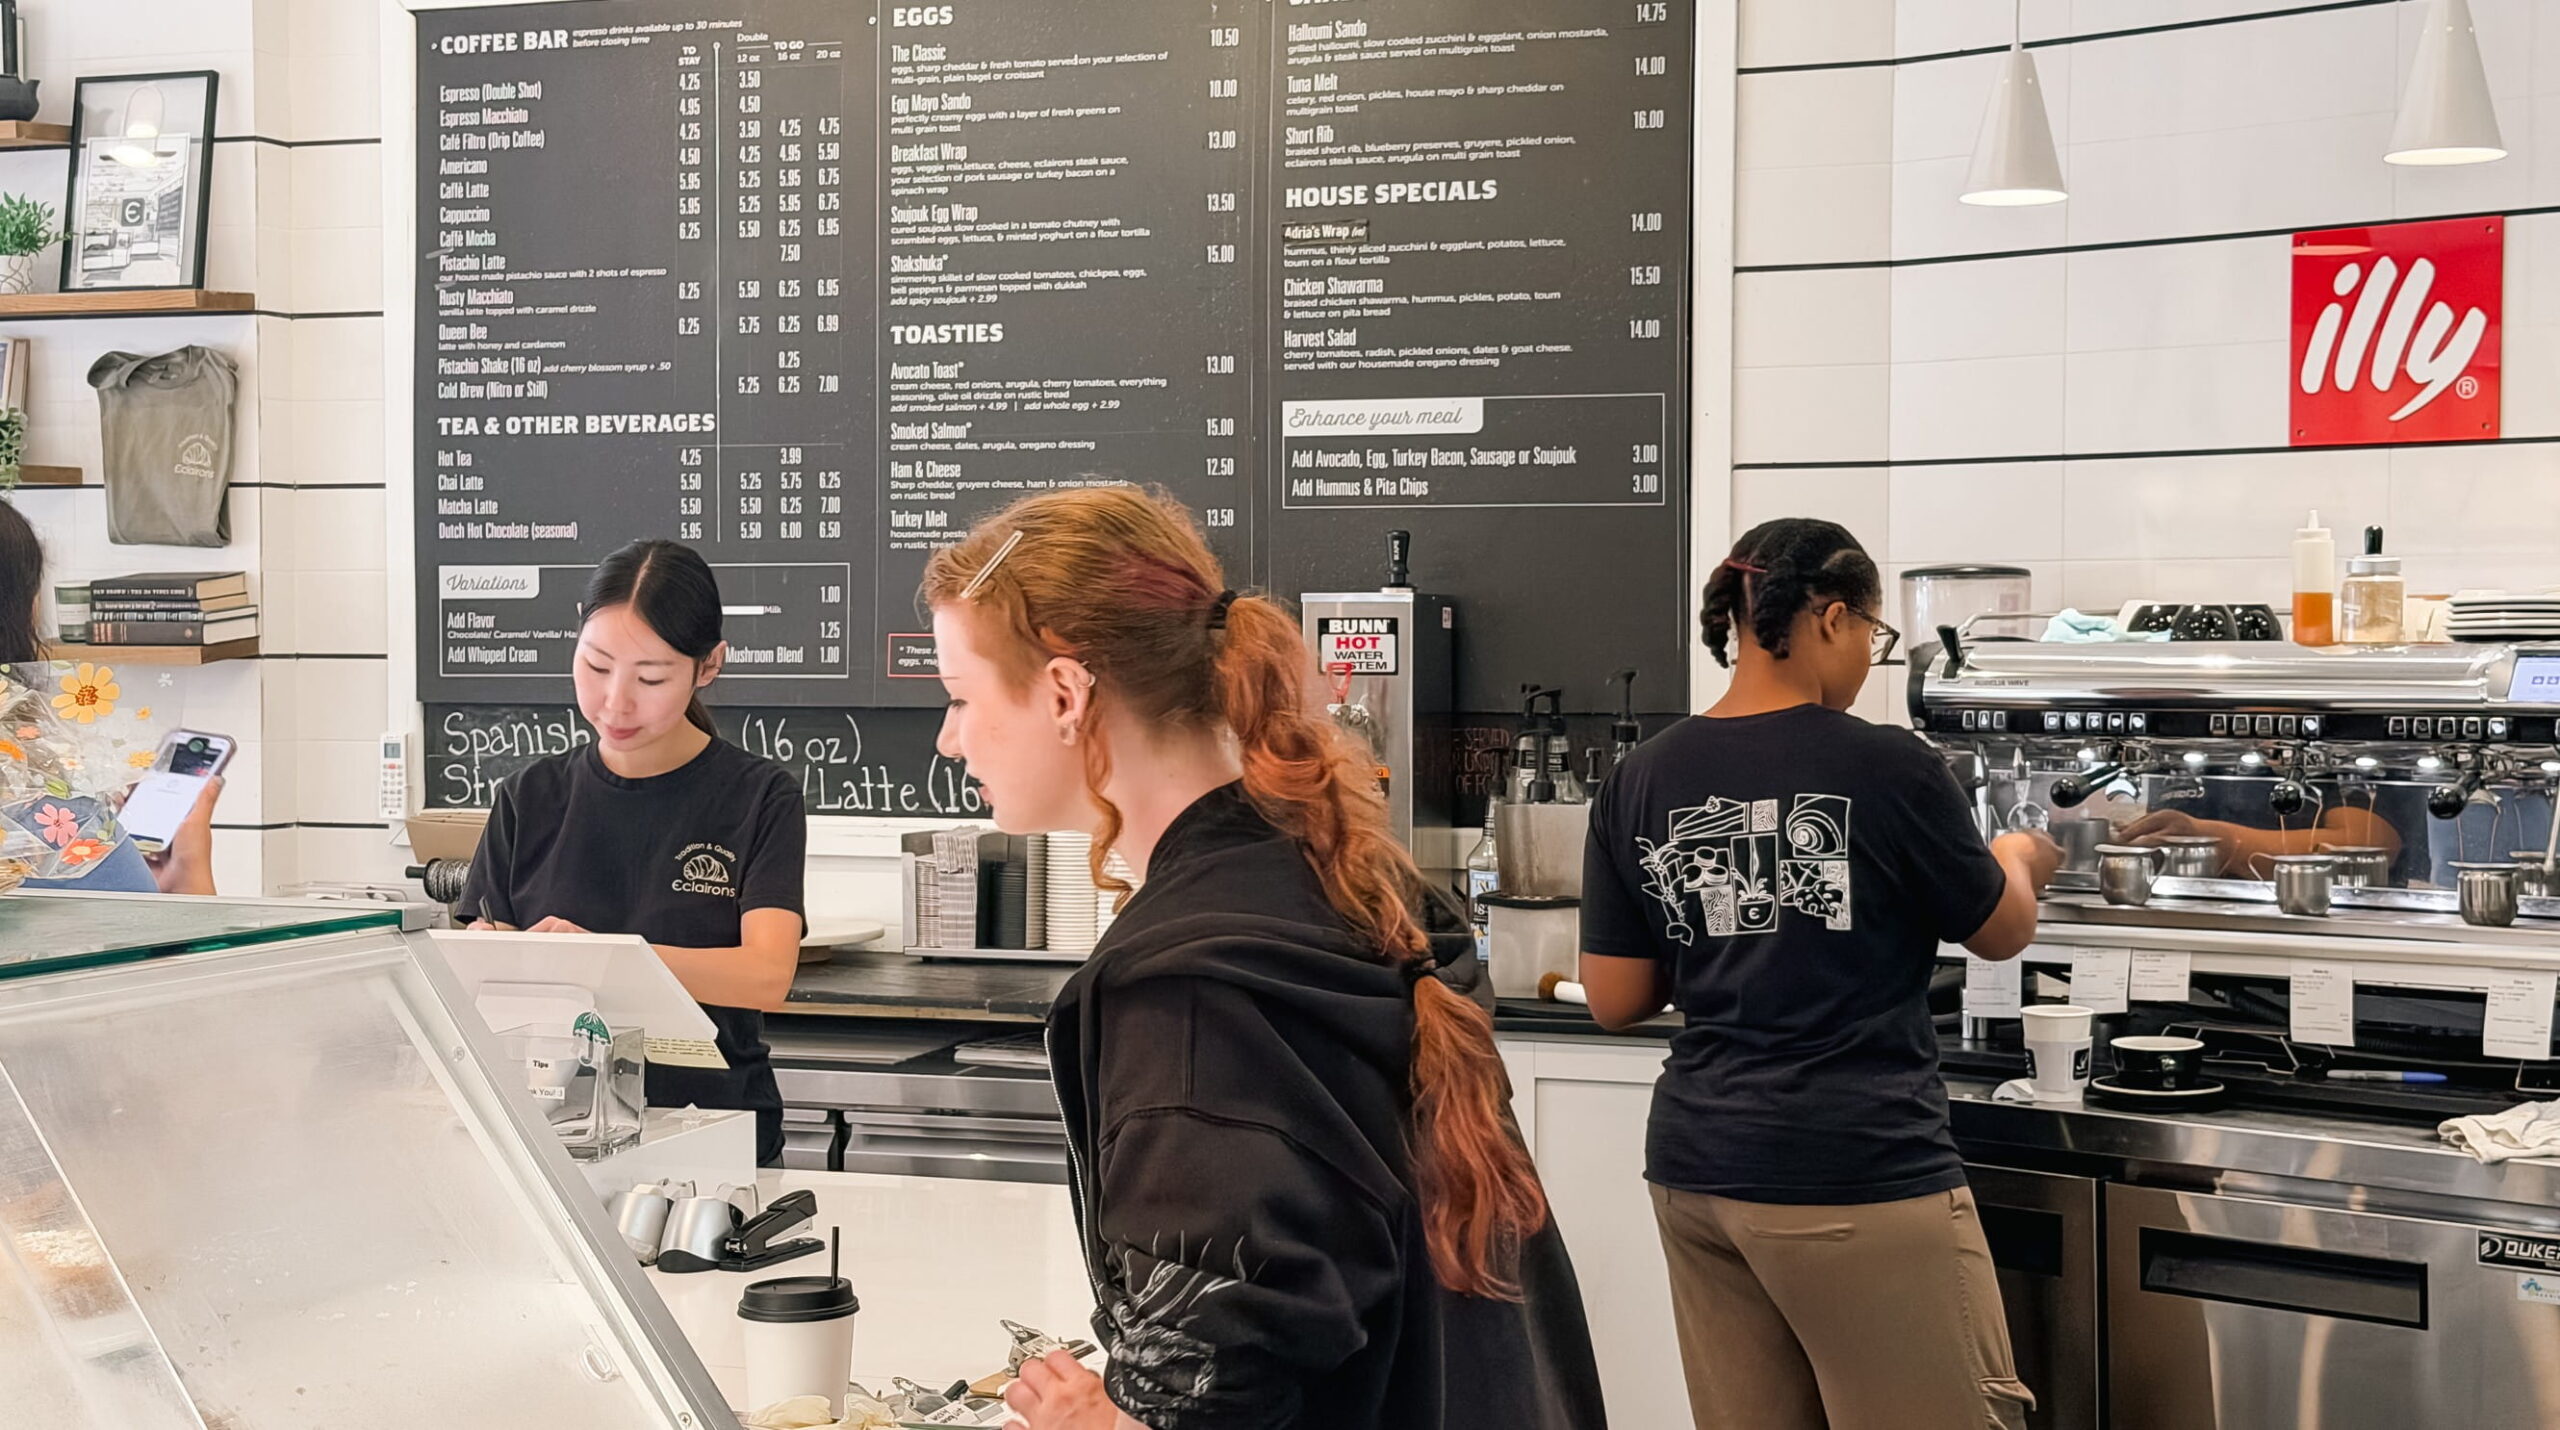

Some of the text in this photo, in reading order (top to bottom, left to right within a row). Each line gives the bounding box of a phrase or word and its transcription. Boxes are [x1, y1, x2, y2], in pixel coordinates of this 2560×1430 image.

[893, 6, 953, 27] EGGS
[1637, 2, 1666, 22] 14.75
[737, 33, 768, 42] Double
[1211, 28, 1239, 47] 10.50
[1288, 19, 1367, 42] Halloumi Sando
[441, 29, 568, 54] COFFEE BAR
[682, 46, 697, 55] TO
[678, 56, 701, 66] STAY
[892, 43, 946, 62] The Classic
[679, 73, 700, 91] 4.25
[739, 70, 760, 88] 3.50
[1287, 73, 1338, 93] Tuna Melt
[440, 81, 542, 104] Espresso (Double Shot)
[892, 92, 971, 115] Egg Mayo Sando
[440, 107, 528, 128] Espresso Macchiato
[1634, 110, 1664, 129] 16.00
[462, 133, 486, 150] Filtro
[488, 132, 510, 151] (Drip
[512, 129, 545, 149] Coffee)
[1208, 130, 1236, 149] 13.00
[1285, 125, 1334, 145] Short Rib
[892, 143, 967, 163] Breakfast Wrap
[439, 157, 487, 175] Americano
[466, 181, 489, 198] Latte
[1286, 180, 1497, 208] HOUSE SPECIALS
[440, 205, 490, 225] Cappuccino
[891, 204, 978, 225] Soujouk Egg Wrap
[466, 229, 496, 246] Mocha
[1322, 224, 1350, 239] Wrap
[440, 254, 506, 271] Pistachio Latte
[1630, 266, 1660, 285] 15.50
[1284, 276, 1383, 296] Chicken Shawarma
[467, 288, 514, 305] Macchiato
[439, 323, 487, 341] Queen Bee
[890, 323, 1003, 344] TOASTIES
[1284, 328, 1356, 348] Harvest Salad
[2300, 255, 2488, 421] illy
[438, 356, 541, 375] Pistachio Shake (16 oz)
[438, 380, 548, 400] Cold Brew (Nitro or Still)
[437, 413, 715, 435] TEA & OTHER BEVERAGES
[1289, 407, 1463, 429] Enhance your meal
[891, 422, 929, 440] Smoked
[438, 450, 472, 467] Hot Tea
[1291, 446, 1576, 469] Add Avocado, Egg, Turkey Bacon, Sausage or Soujouk
[1633, 445, 1657, 463] 3.00
[891, 460, 961, 478] Ham & Cheese
[1206, 458, 1234, 476] 12.50
[438, 474, 484, 491] Chai Latte
[1292, 477, 1428, 498] Add Hummus & Pita Chips
[438, 498, 498, 515] Matcha Latte
[891, 510, 948, 529] Turkey Melt
[439, 522, 578, 540] Dutch Hot Chocolate (seasonal)
[446, 574, 528, 591] Variations
[447, 612, 496, 629] Add Flavor
[821, 621, 840, 639] 1.25
[1329, 619, 1388, 633] BUNN
[1336, 637, 1381, 649] HOT
[448, 646, 538, 665] Add Whipped Cream
[725, 646, 803, 663] Mushroom Blend
[1334, 651, 1383, 660] WATER
[1348, 661, 1387, 670] STEM
[444, 709, 591, 769] Spanish
[742, 713, 861, 765] (16 oz)
[444, 764, 505, 806] Str
